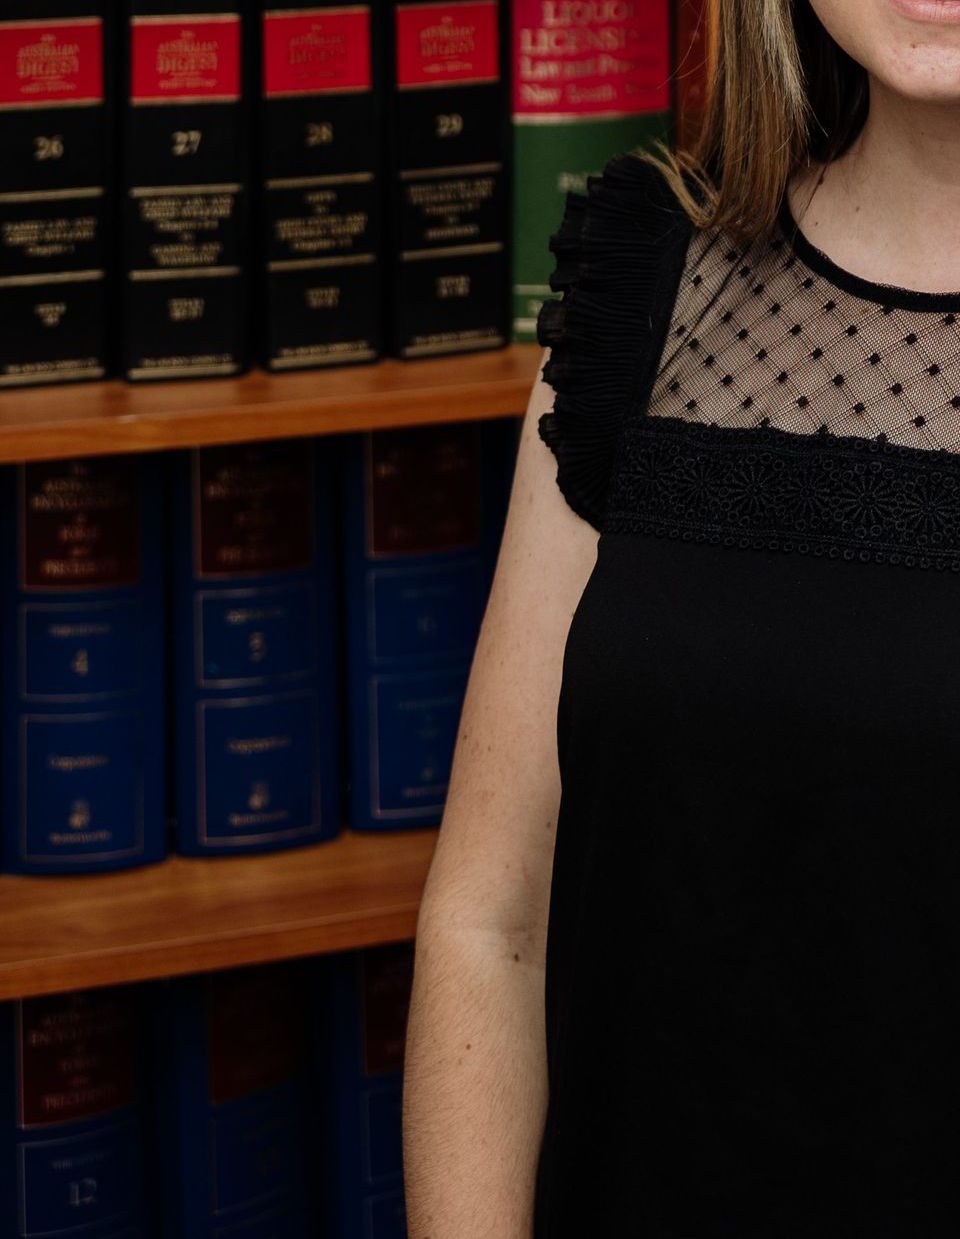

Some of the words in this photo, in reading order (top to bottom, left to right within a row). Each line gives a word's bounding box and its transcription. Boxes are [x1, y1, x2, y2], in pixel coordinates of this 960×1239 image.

[542, 0, 634, 28] LIQUO
[520, 83, 561, 106] New
[33, 134, 64, 160] 26
[171, 130, 201, 156] 27
[71, 650, 90, 676] 4
[69, 1176, 98, 1207] 12
